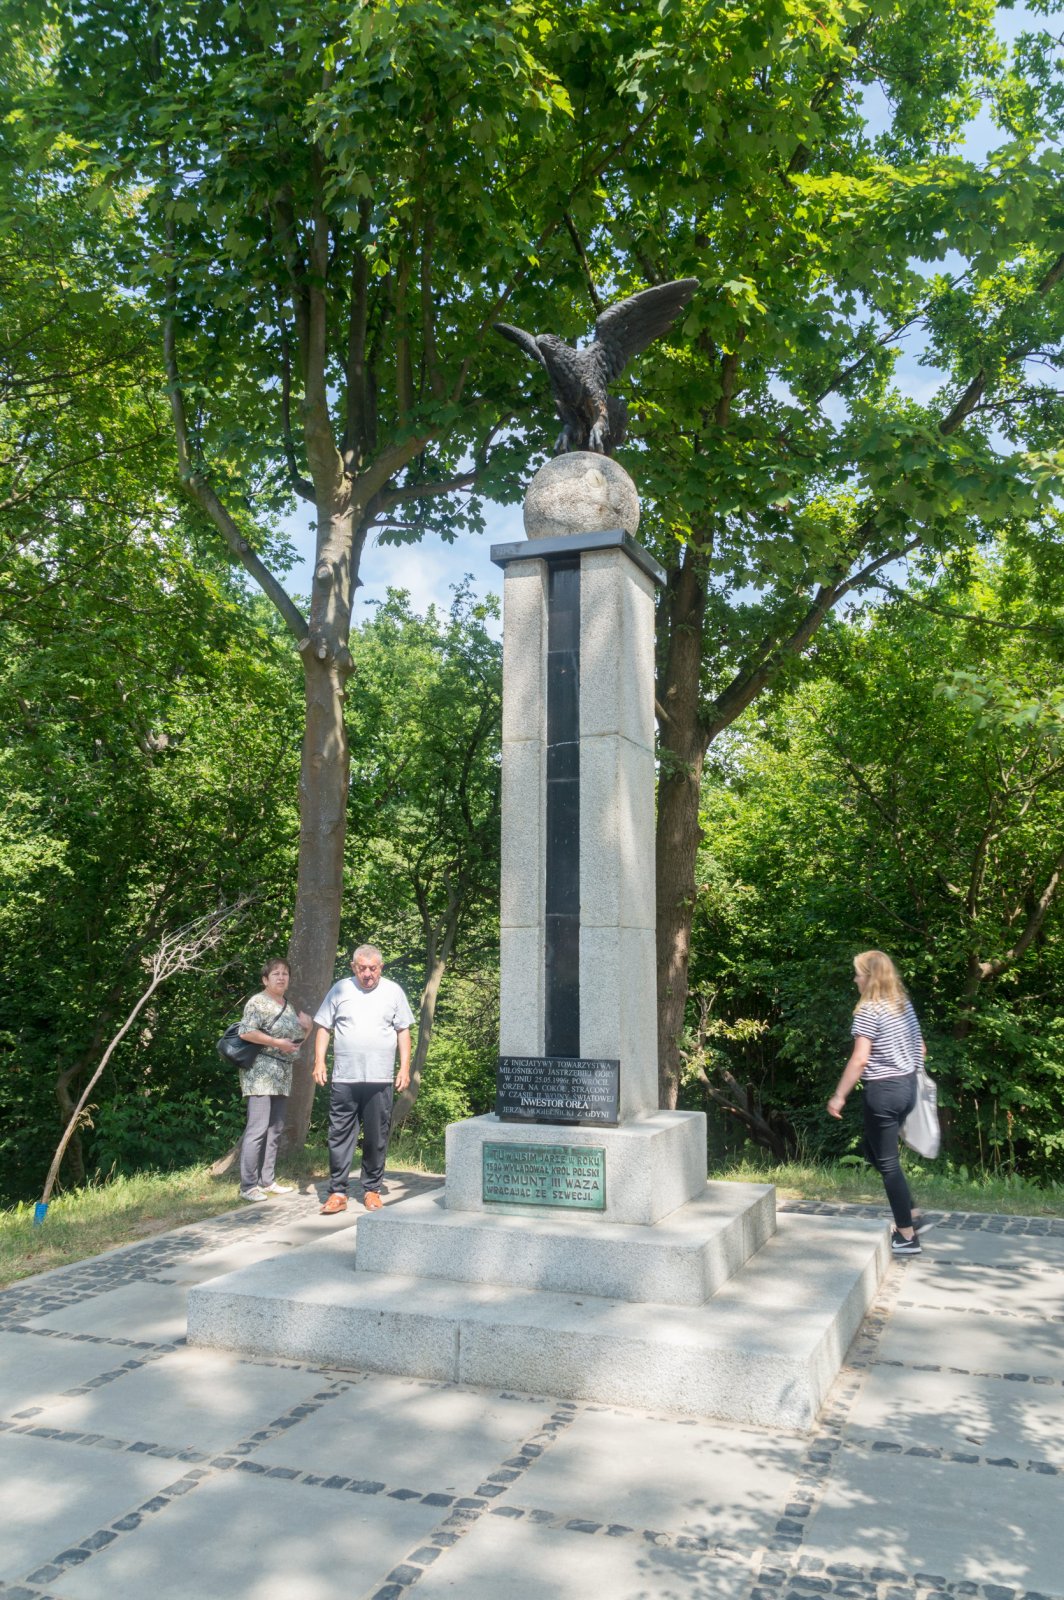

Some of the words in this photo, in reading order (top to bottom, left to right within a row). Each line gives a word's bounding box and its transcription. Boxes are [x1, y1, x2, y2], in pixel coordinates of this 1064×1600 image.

[521, 1098, 563, 1107] INWESTOR
[573, 1094, 614, 1102] ŚWIATOWEJ
[493, 1150, 504, 1160] TU
[540, 1154, 565, 1164] JARZE
[578, 1156, 599, 1165] ROKU
[504, 1164, 549, 1174] WYLĄDOWAŁ
[552, 1166, 570, 1175] KRÓL
[573, 1168, 599, 1177] POLSKI
[487, 1174, 546, 1186] ZYGMUNT
[552, 1178, 560, 1187] III
[566, 1179, 599, 1190] WAZA
